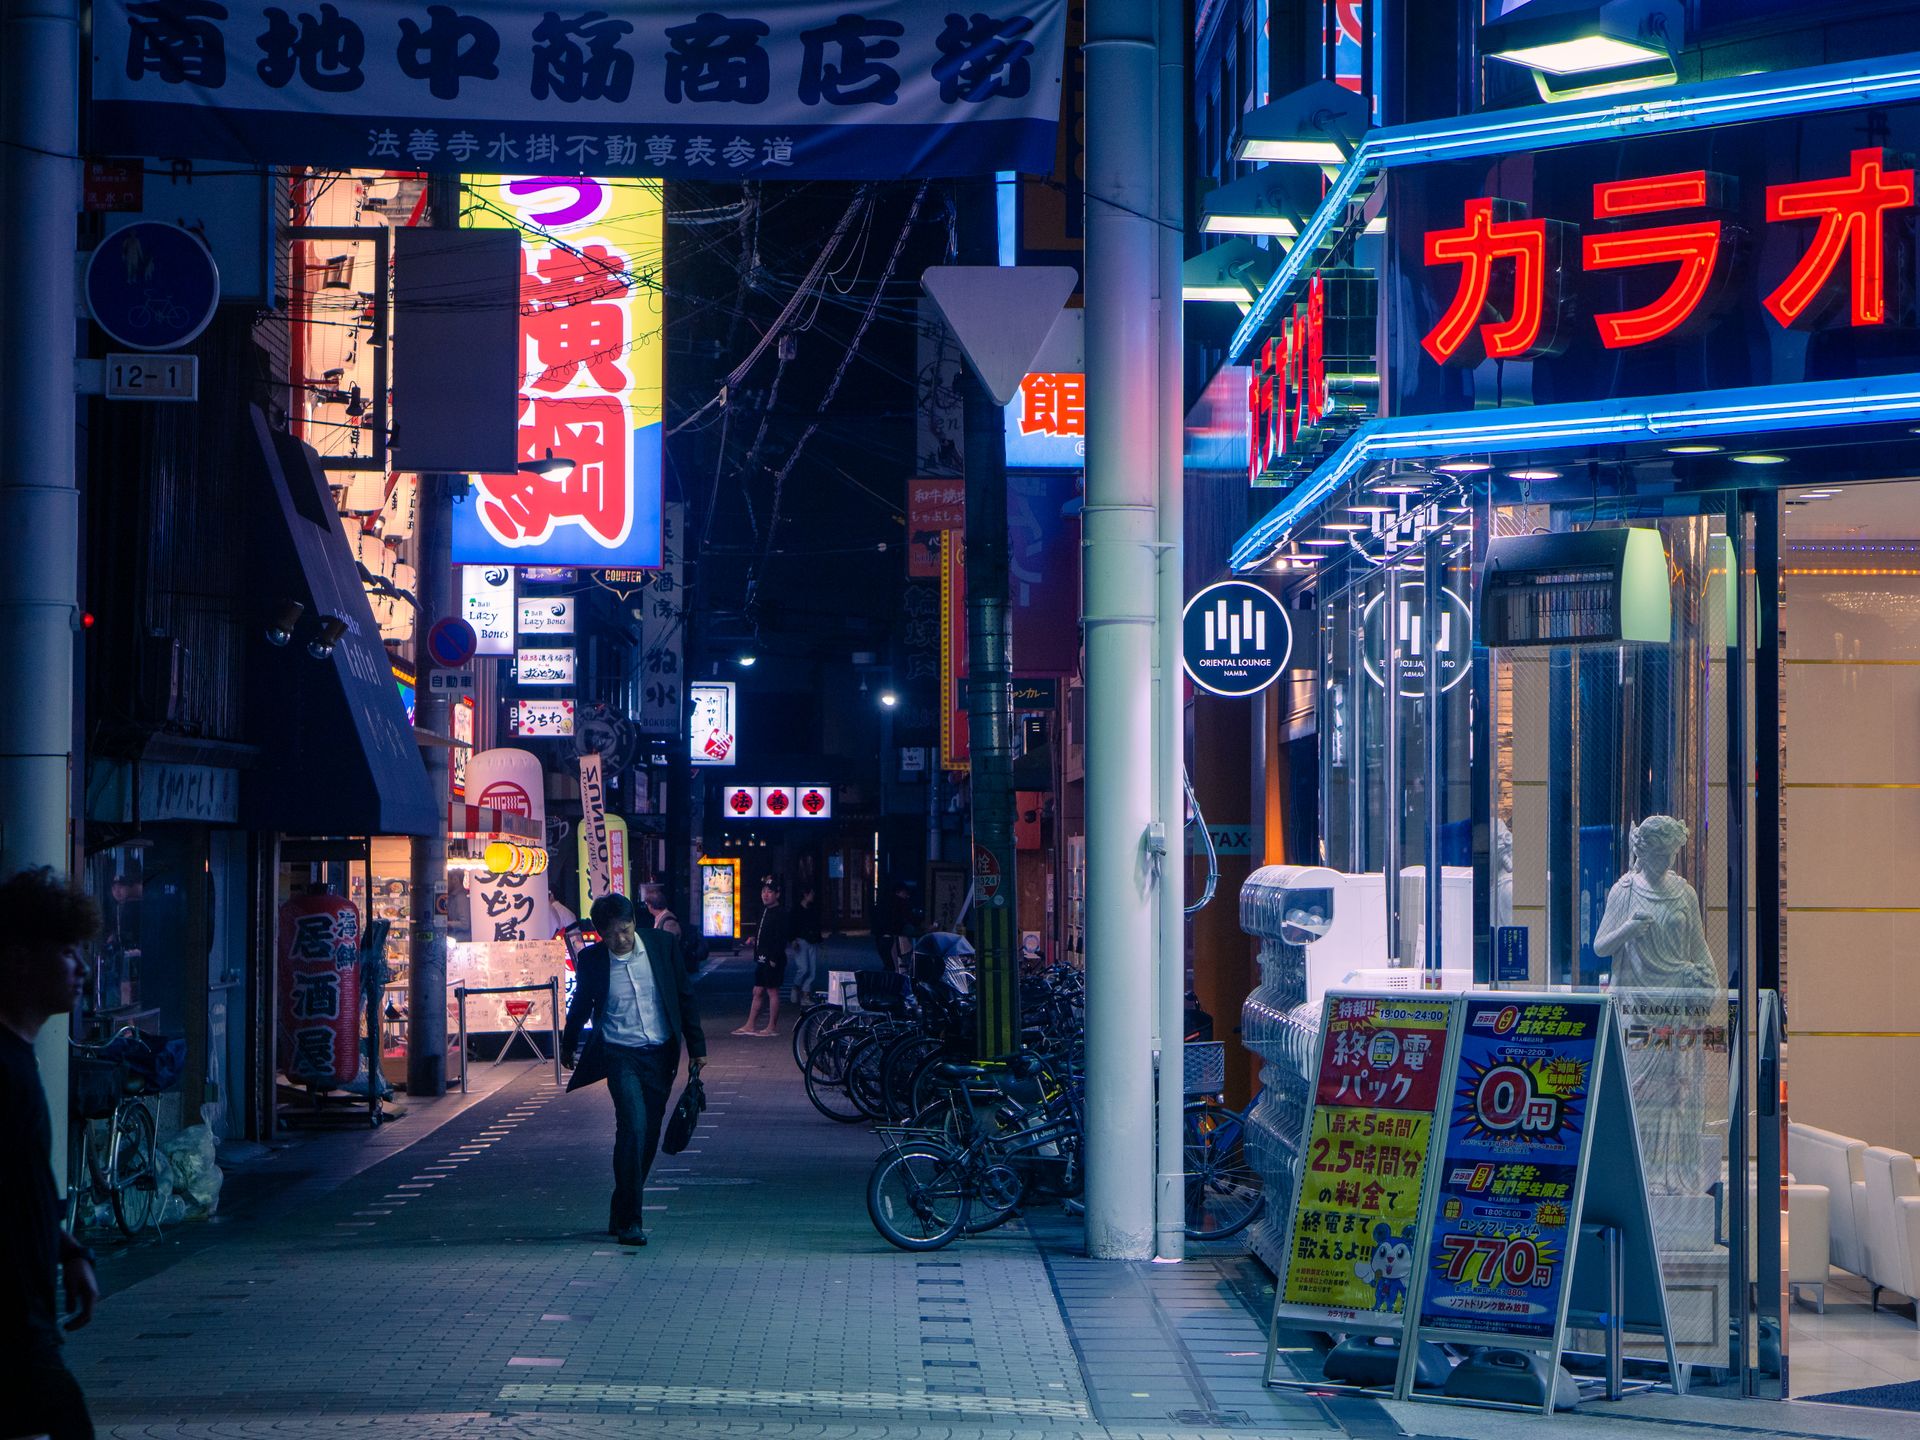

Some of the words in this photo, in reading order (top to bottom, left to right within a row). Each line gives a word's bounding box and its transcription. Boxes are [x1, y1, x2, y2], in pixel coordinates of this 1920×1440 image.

[126, 3, 1035, 104] 南地中筋商店街
[367, 128, 795, 168] 法善寺水掛不動尊表参道
[1422, 147, 1914, 366] カラオ
[605, 569, 642, 583] COUNTER
[469, 611, 498, 626] Lazy
[524, 618, 544, 629] Lazy
[481, 629, 509, 639] Bones
[1199, 659, 1237, 667] ORIENTAL
[1238, 659, 1271, 667] LOUNGE
[432, 675, 472, 688] 自動車
[526, 710, 562, 727] うちわ
[734, 795, 822, 811] 法善寺
[288, 912, 340, 1077] 居酒屋
[1622, 1004, 1681, 1016] KARAOKE
[1684, 1006, 1710, 1017] KAN
[1515, 1020, 1587, 1037] 高校生限定
[1335, 1069, 1413, 1104] パック
[1312, 1138, 1422, 1178] 2.5時間分
[1318, 1180, 1404, 1210] の料金で
[1301, 1211, 1375, 1234] 終電まで
[1459, 1219, 1541, 1235] ロングフリータイム
[1443, 1234, 1552, 1287] 770円
[1450, 1298, 1530, 1314] ソフトドリンク飲み放題
